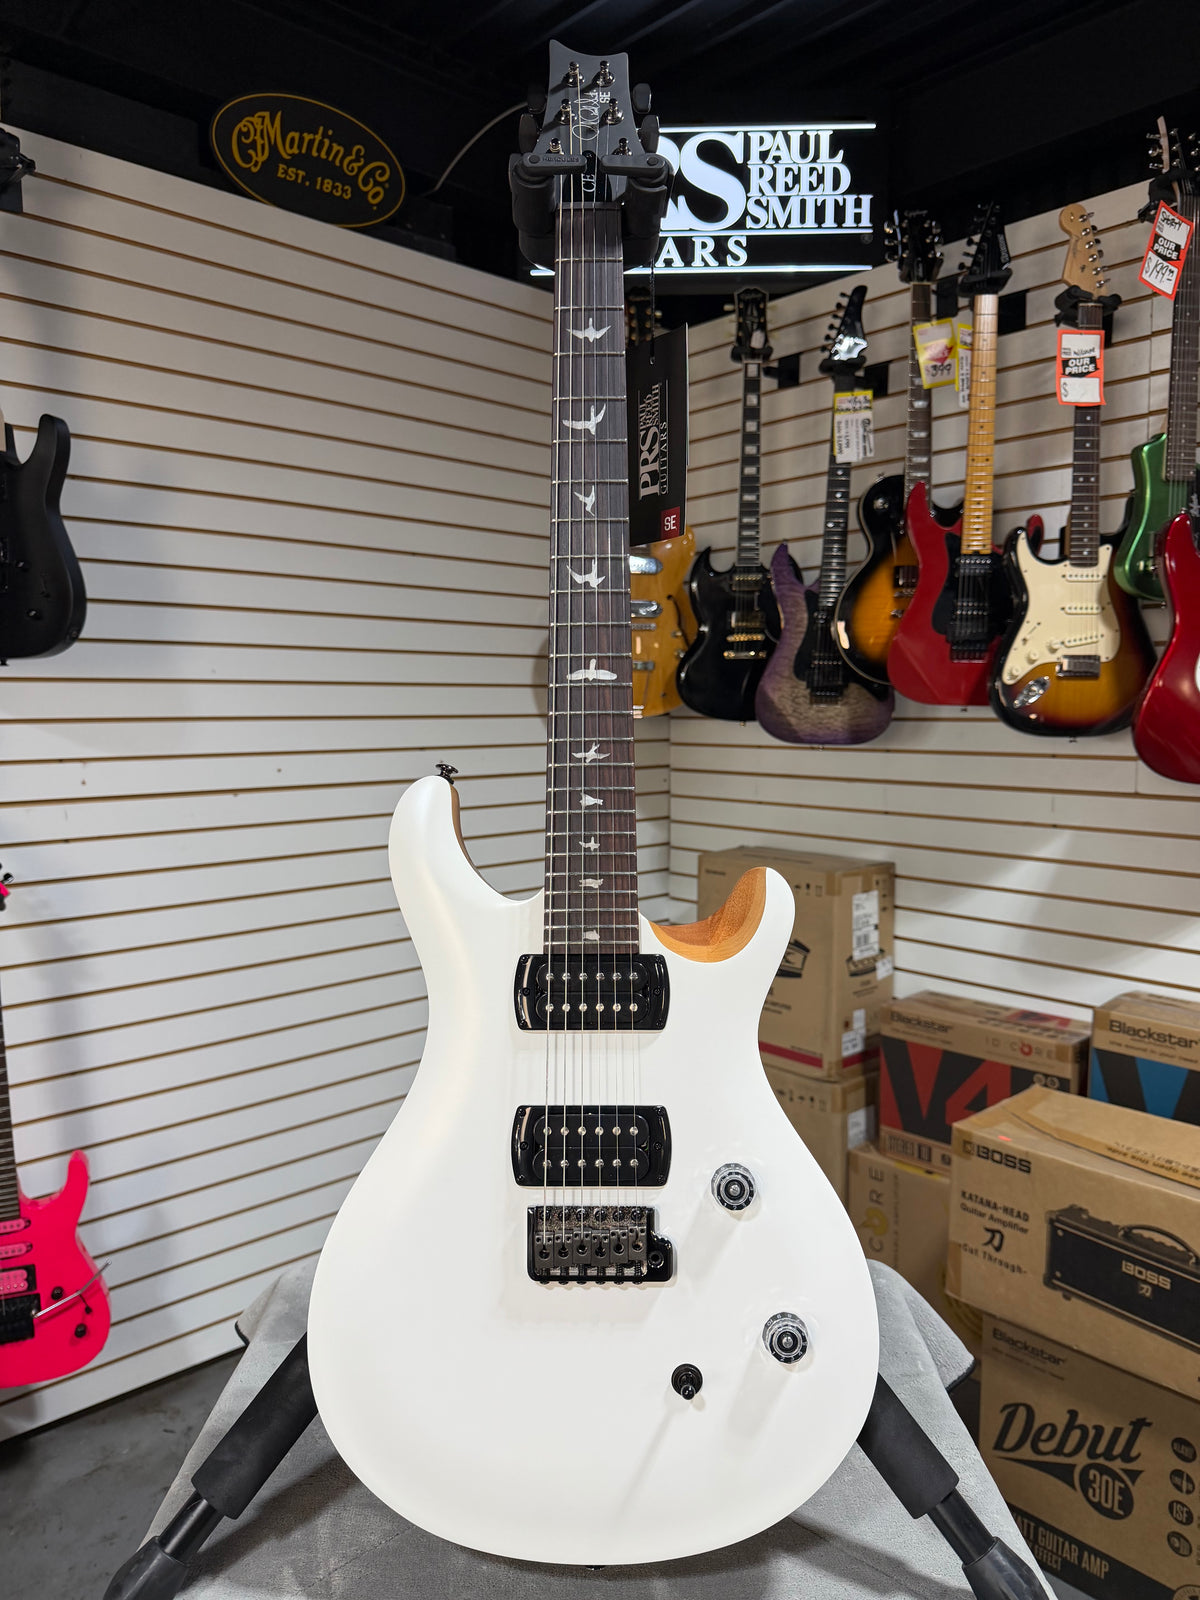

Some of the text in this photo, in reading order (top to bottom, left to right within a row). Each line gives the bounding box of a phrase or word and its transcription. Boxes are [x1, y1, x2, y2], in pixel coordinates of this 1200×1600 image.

[600, 91, 611, 104] SE
[747, 130, 844, 164] PAUL
[276, 164, 352, 200] EST. 1833
[747, 163, 852, 197] REED
[746, 194, 874, 230] SMITH
[1153, 243, 1179, 260] PRICE
[1157, 237, 1176, 251] OUR
[1065, 364, 1096, 375] PRICE
[1068, 357, 1091, 367] OUR
[651, 384, 660, 426] SMITH
[638, 426, 660, 501] PRS
[659, 421, 668, 495] GUITARS
[664, 514, 677, 531] SE
[1108, 1018, 1199, 1049] Blackstar
[976, 1144, 1033, 1175] BOSS
[959, 1202, 1030, 1236] Guitar Amplifier
[960, 1189, 1030, 1223] KATANA-HEAD
[1121, 1259, 1172, 1290] BOSS
[992, 1402, 1153, 1464] Debut
[1086, 1469, 1127, 1518] 30E
[1172, 1501, 1189, 1524] ISF
[1014, 1511, 1110, 1580] ATT GUITAR AMP
